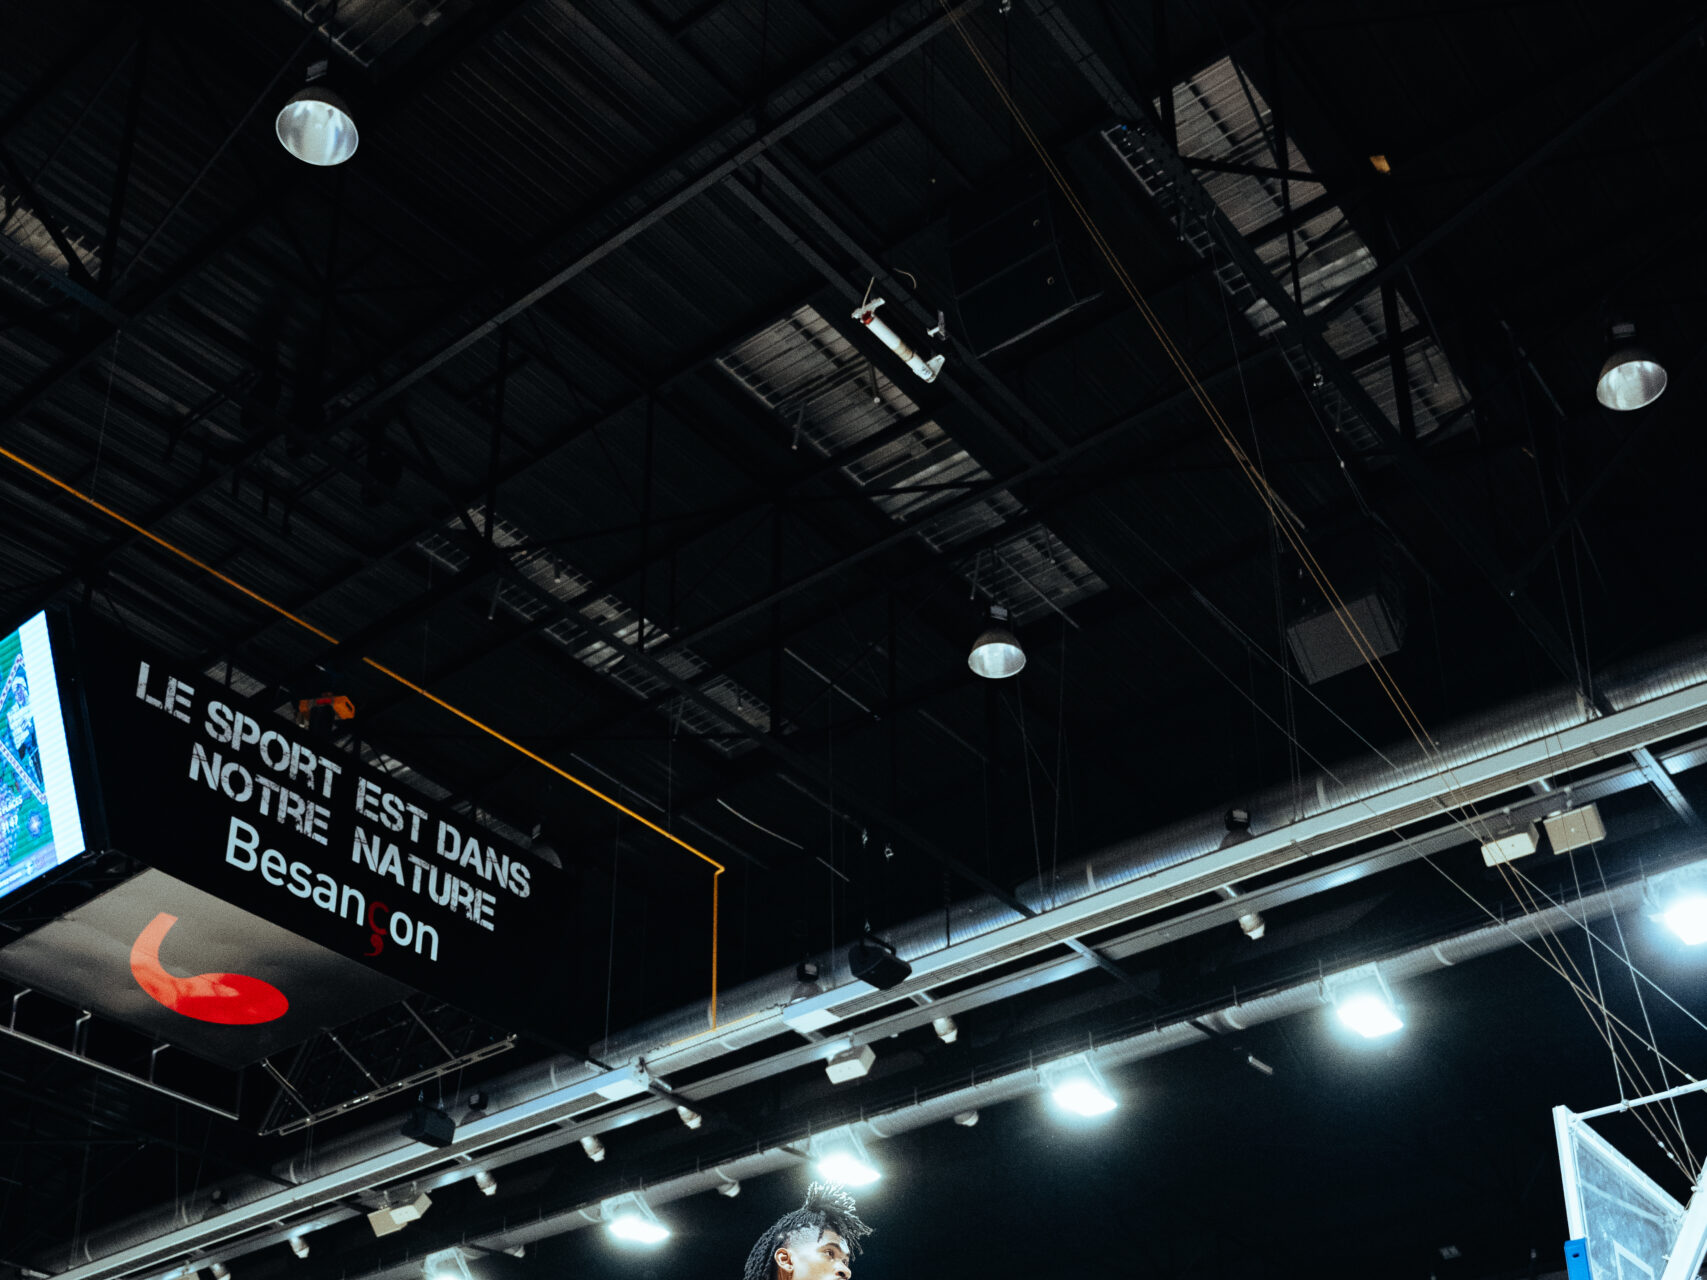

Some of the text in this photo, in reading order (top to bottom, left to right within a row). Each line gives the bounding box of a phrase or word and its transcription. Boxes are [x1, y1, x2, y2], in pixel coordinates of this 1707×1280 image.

[136, 661, 531, 898] LE SPORT EST DANS
[188, 742, 496, 932] NOTRE NATURE
[225, 815, 439, 962] Besançon
